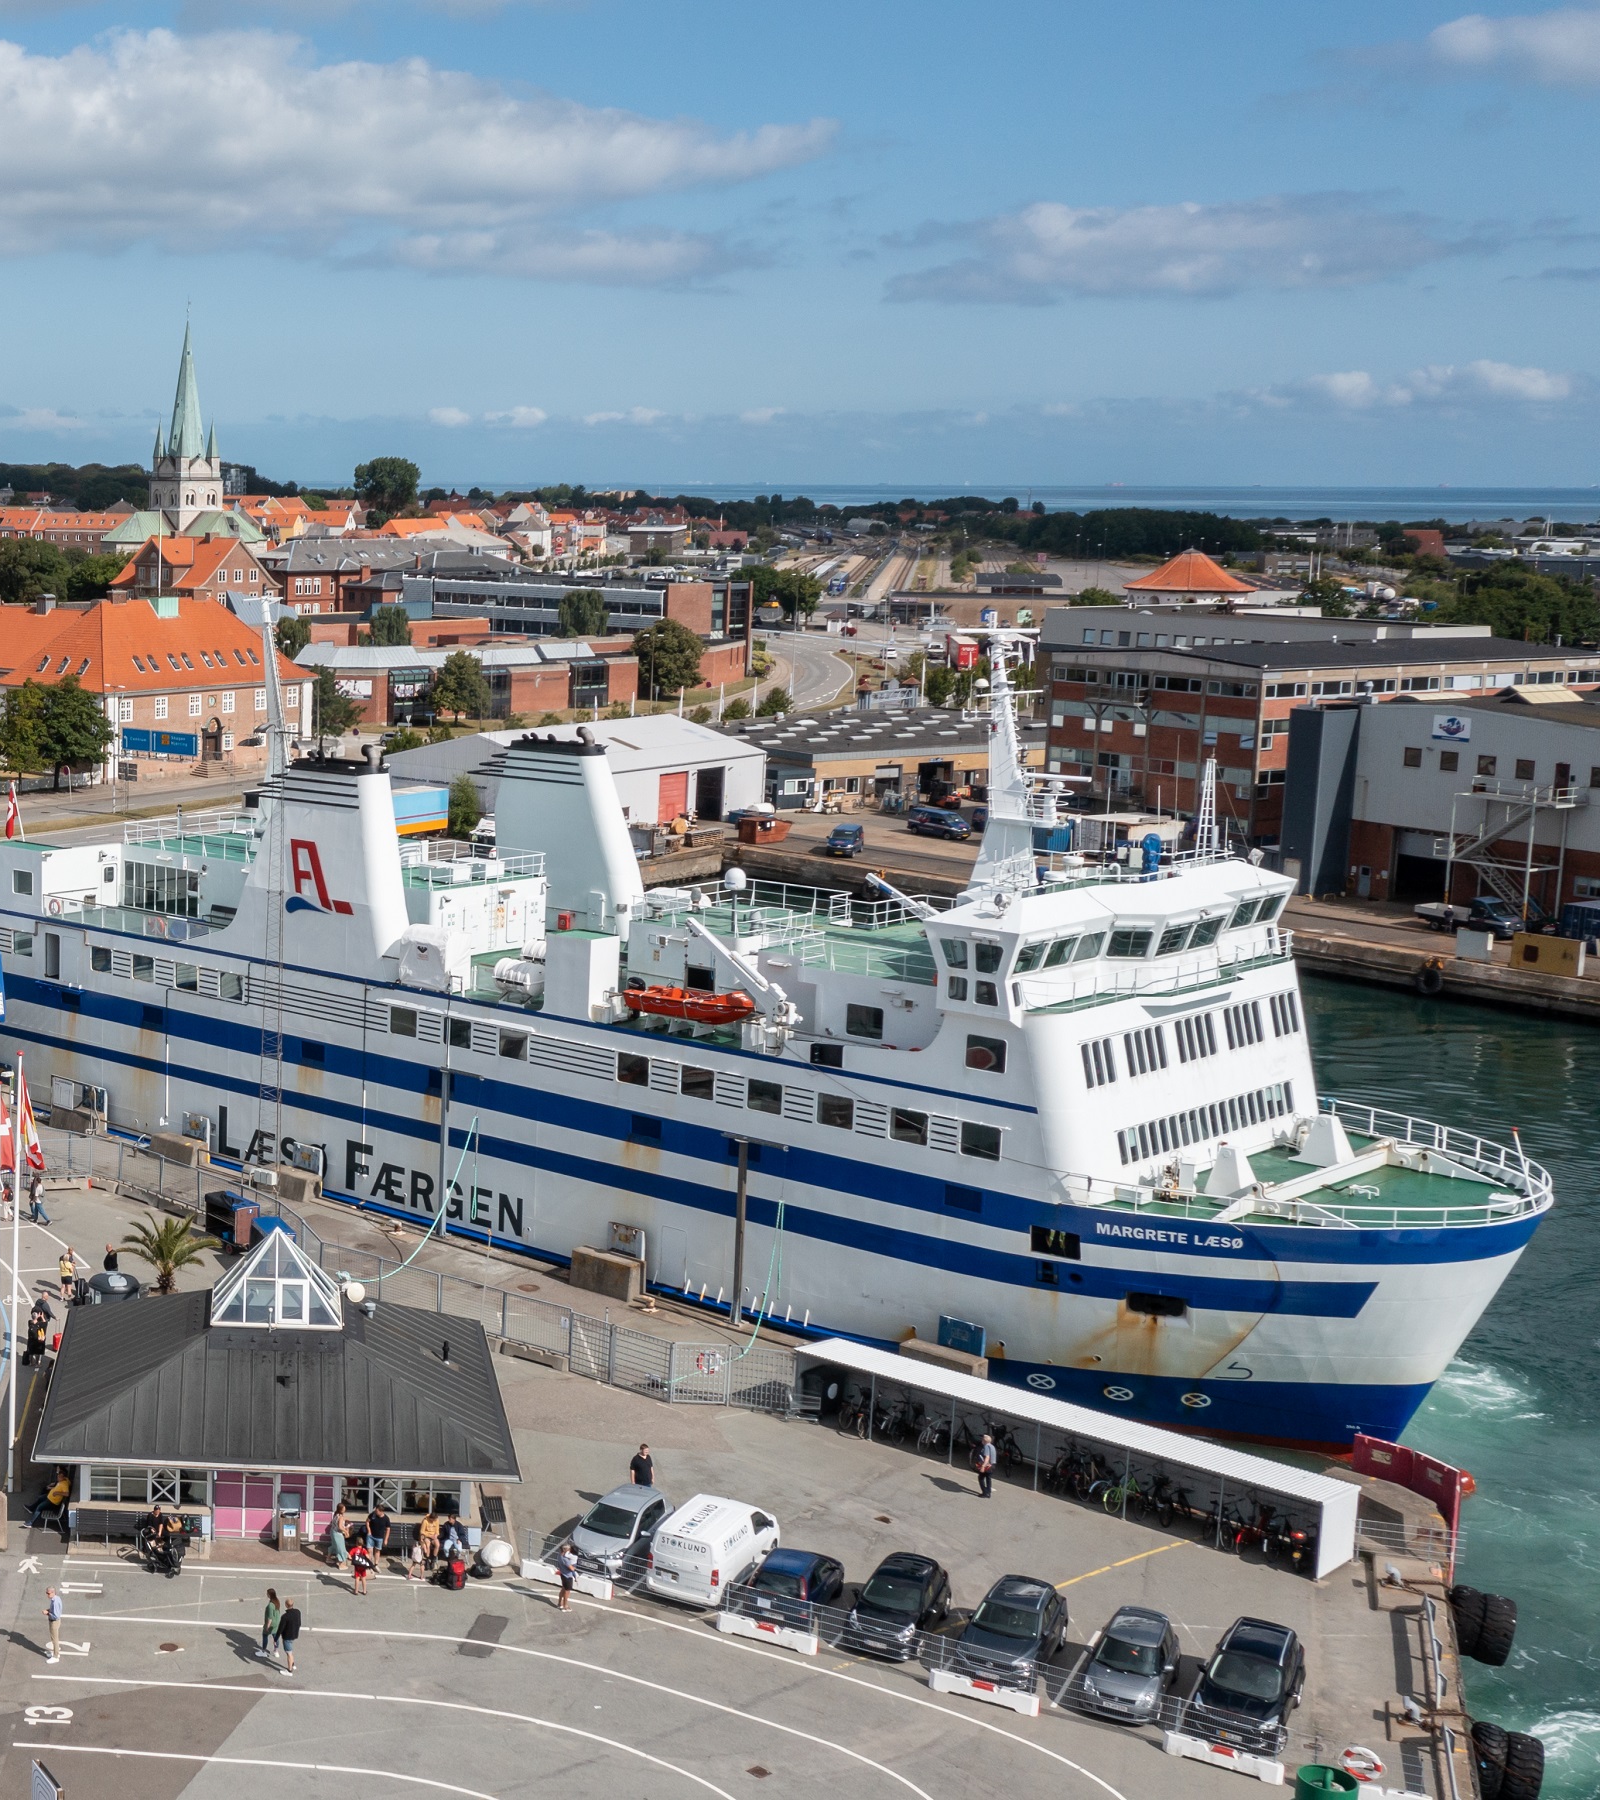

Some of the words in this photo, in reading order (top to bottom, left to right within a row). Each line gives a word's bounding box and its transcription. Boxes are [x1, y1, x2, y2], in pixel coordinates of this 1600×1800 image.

[346, 1139, 523, 1237] FÆRGEN
[1096, 1222, 1188, 1245] MARGRETE
[1194, 1234, 1244, 1250] LÆSØ
[661, 1536, 707, 1554] STOKLUND
[59, 1581, 104, 1594] 11
[23, 1705, 74, 1725] 13
